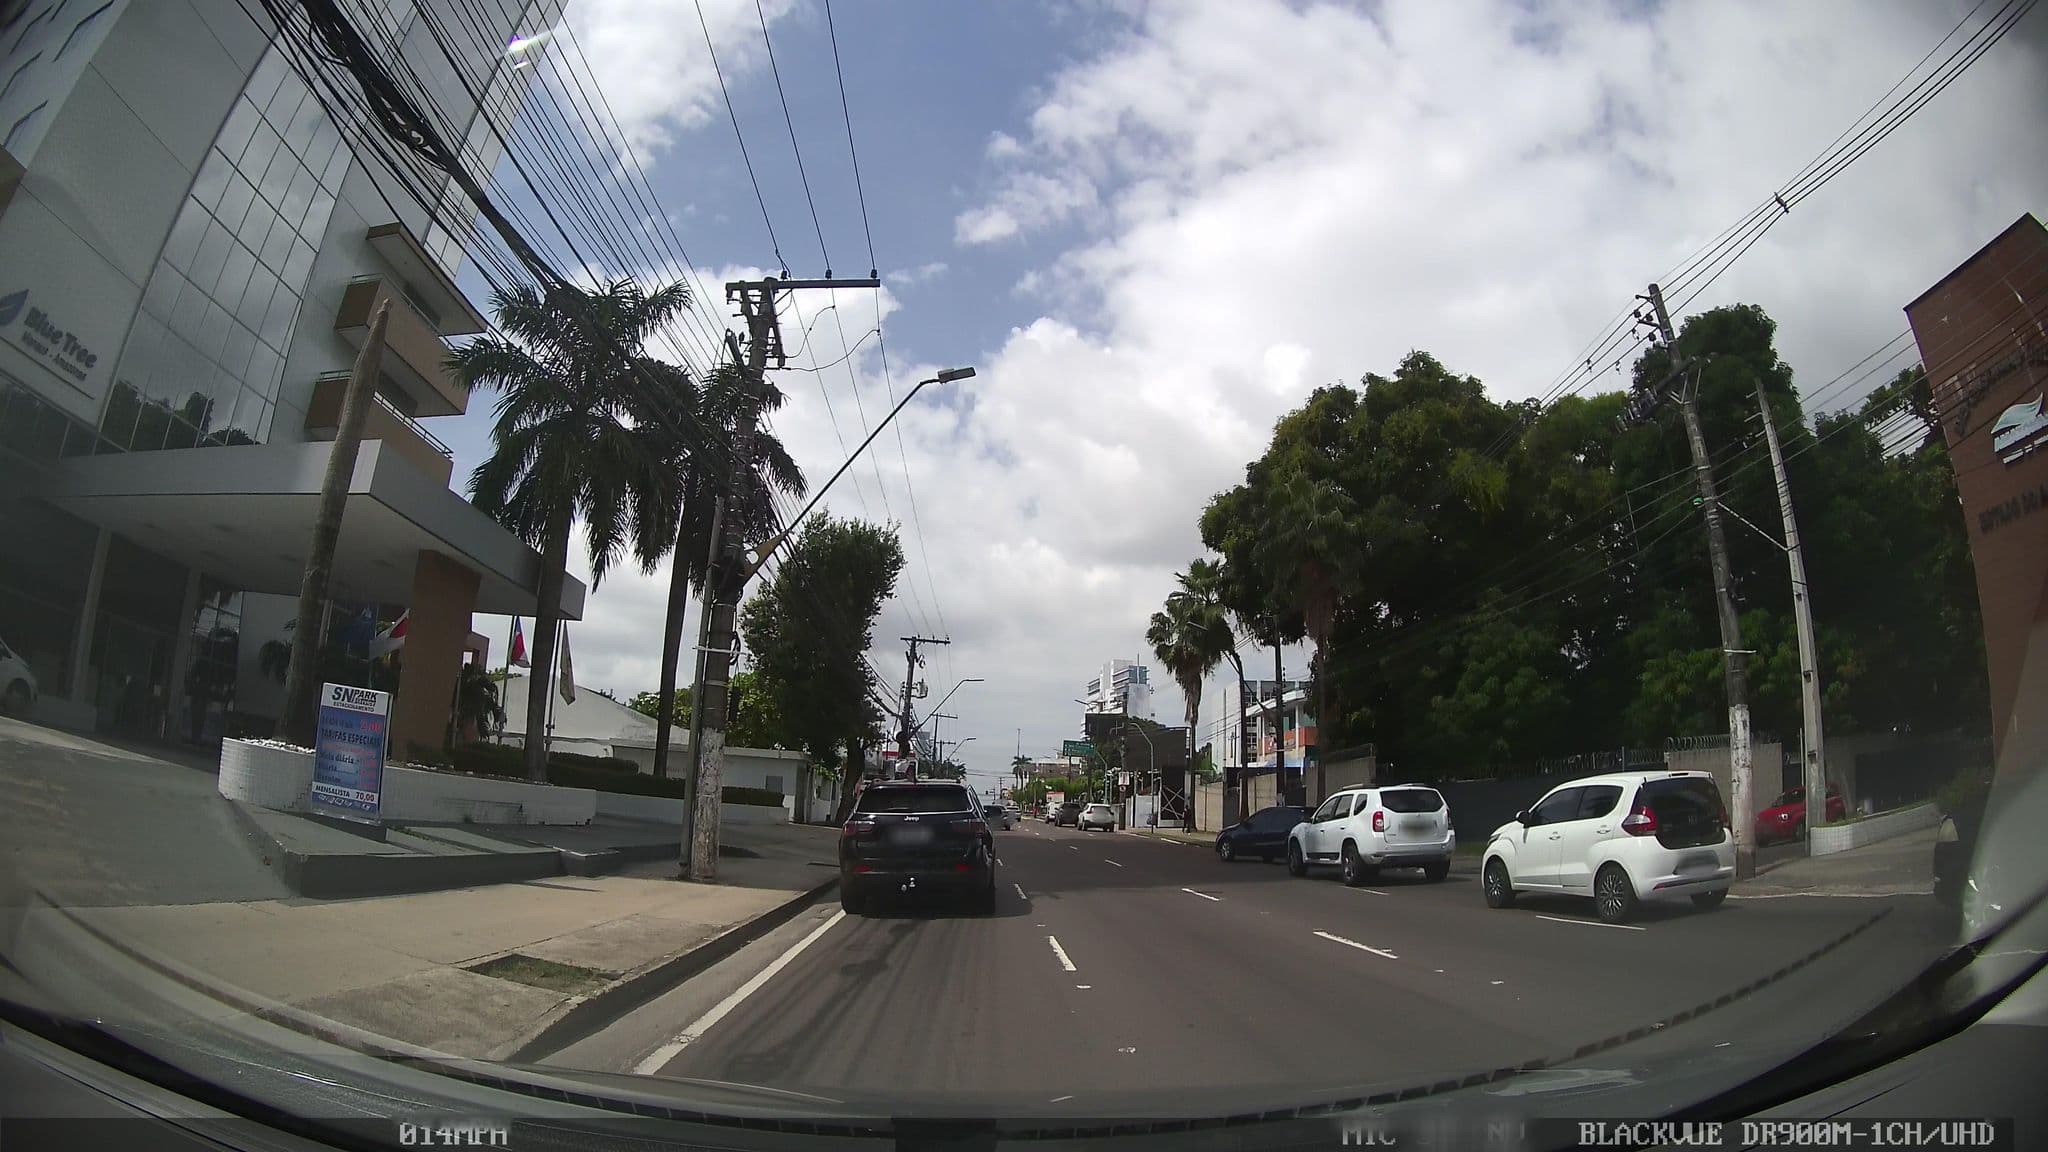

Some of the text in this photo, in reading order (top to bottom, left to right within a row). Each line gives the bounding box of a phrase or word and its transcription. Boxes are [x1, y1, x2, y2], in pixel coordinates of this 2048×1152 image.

[24, 307, 97, 368] Blue Tree
[332, 686, 378, 703] SN PARK
[315, 785, 350, 797] MENSALISTA
